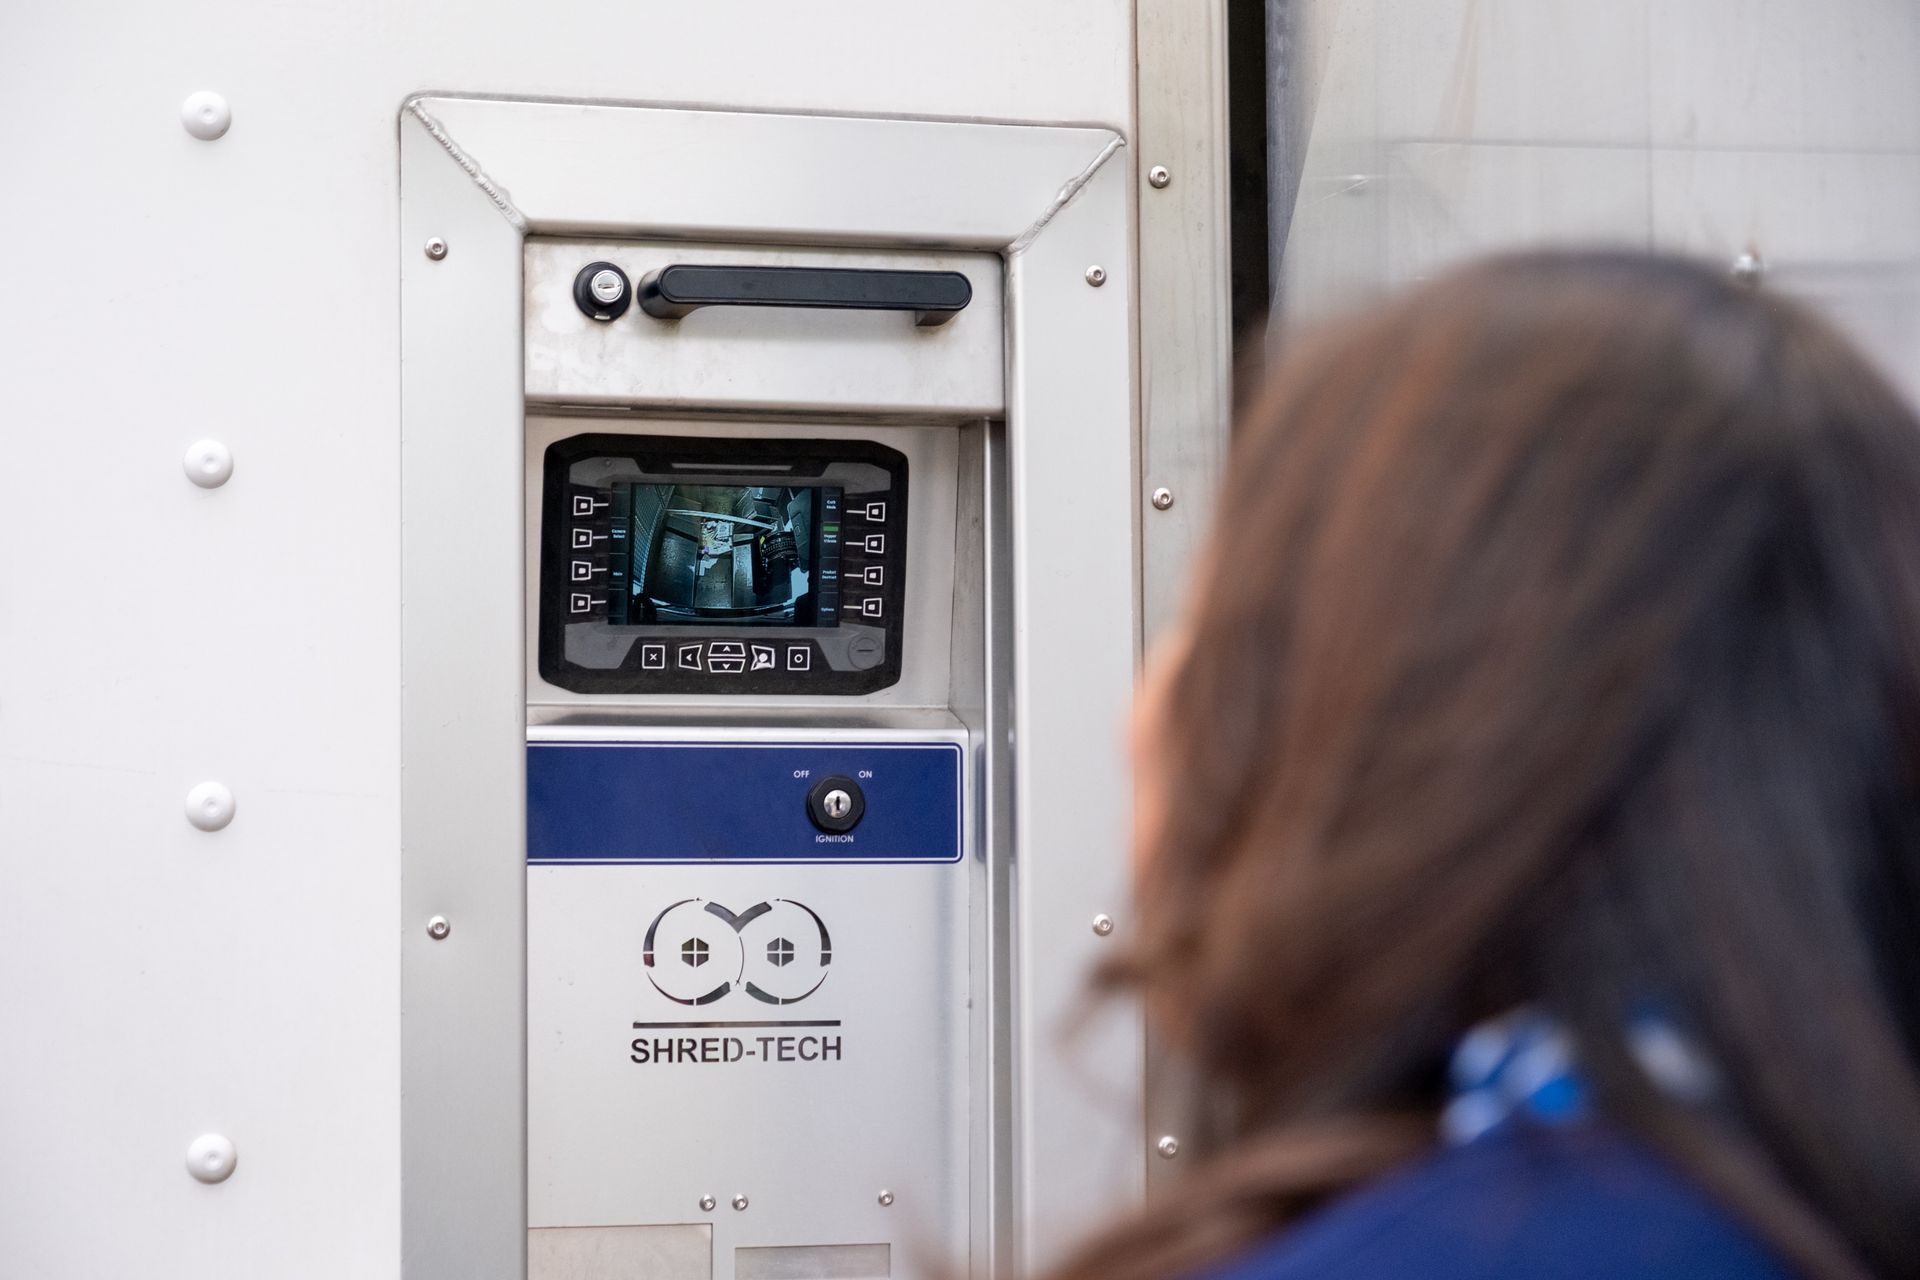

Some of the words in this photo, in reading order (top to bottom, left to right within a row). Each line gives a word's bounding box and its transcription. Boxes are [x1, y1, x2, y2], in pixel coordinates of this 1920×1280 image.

[793, 770, 810, 778] OFF
[858, 770, 873, 778] ON
[815, 835, 854, 843] IGNITION
[630, 1036, 842, 1064] SHRED-TECH
